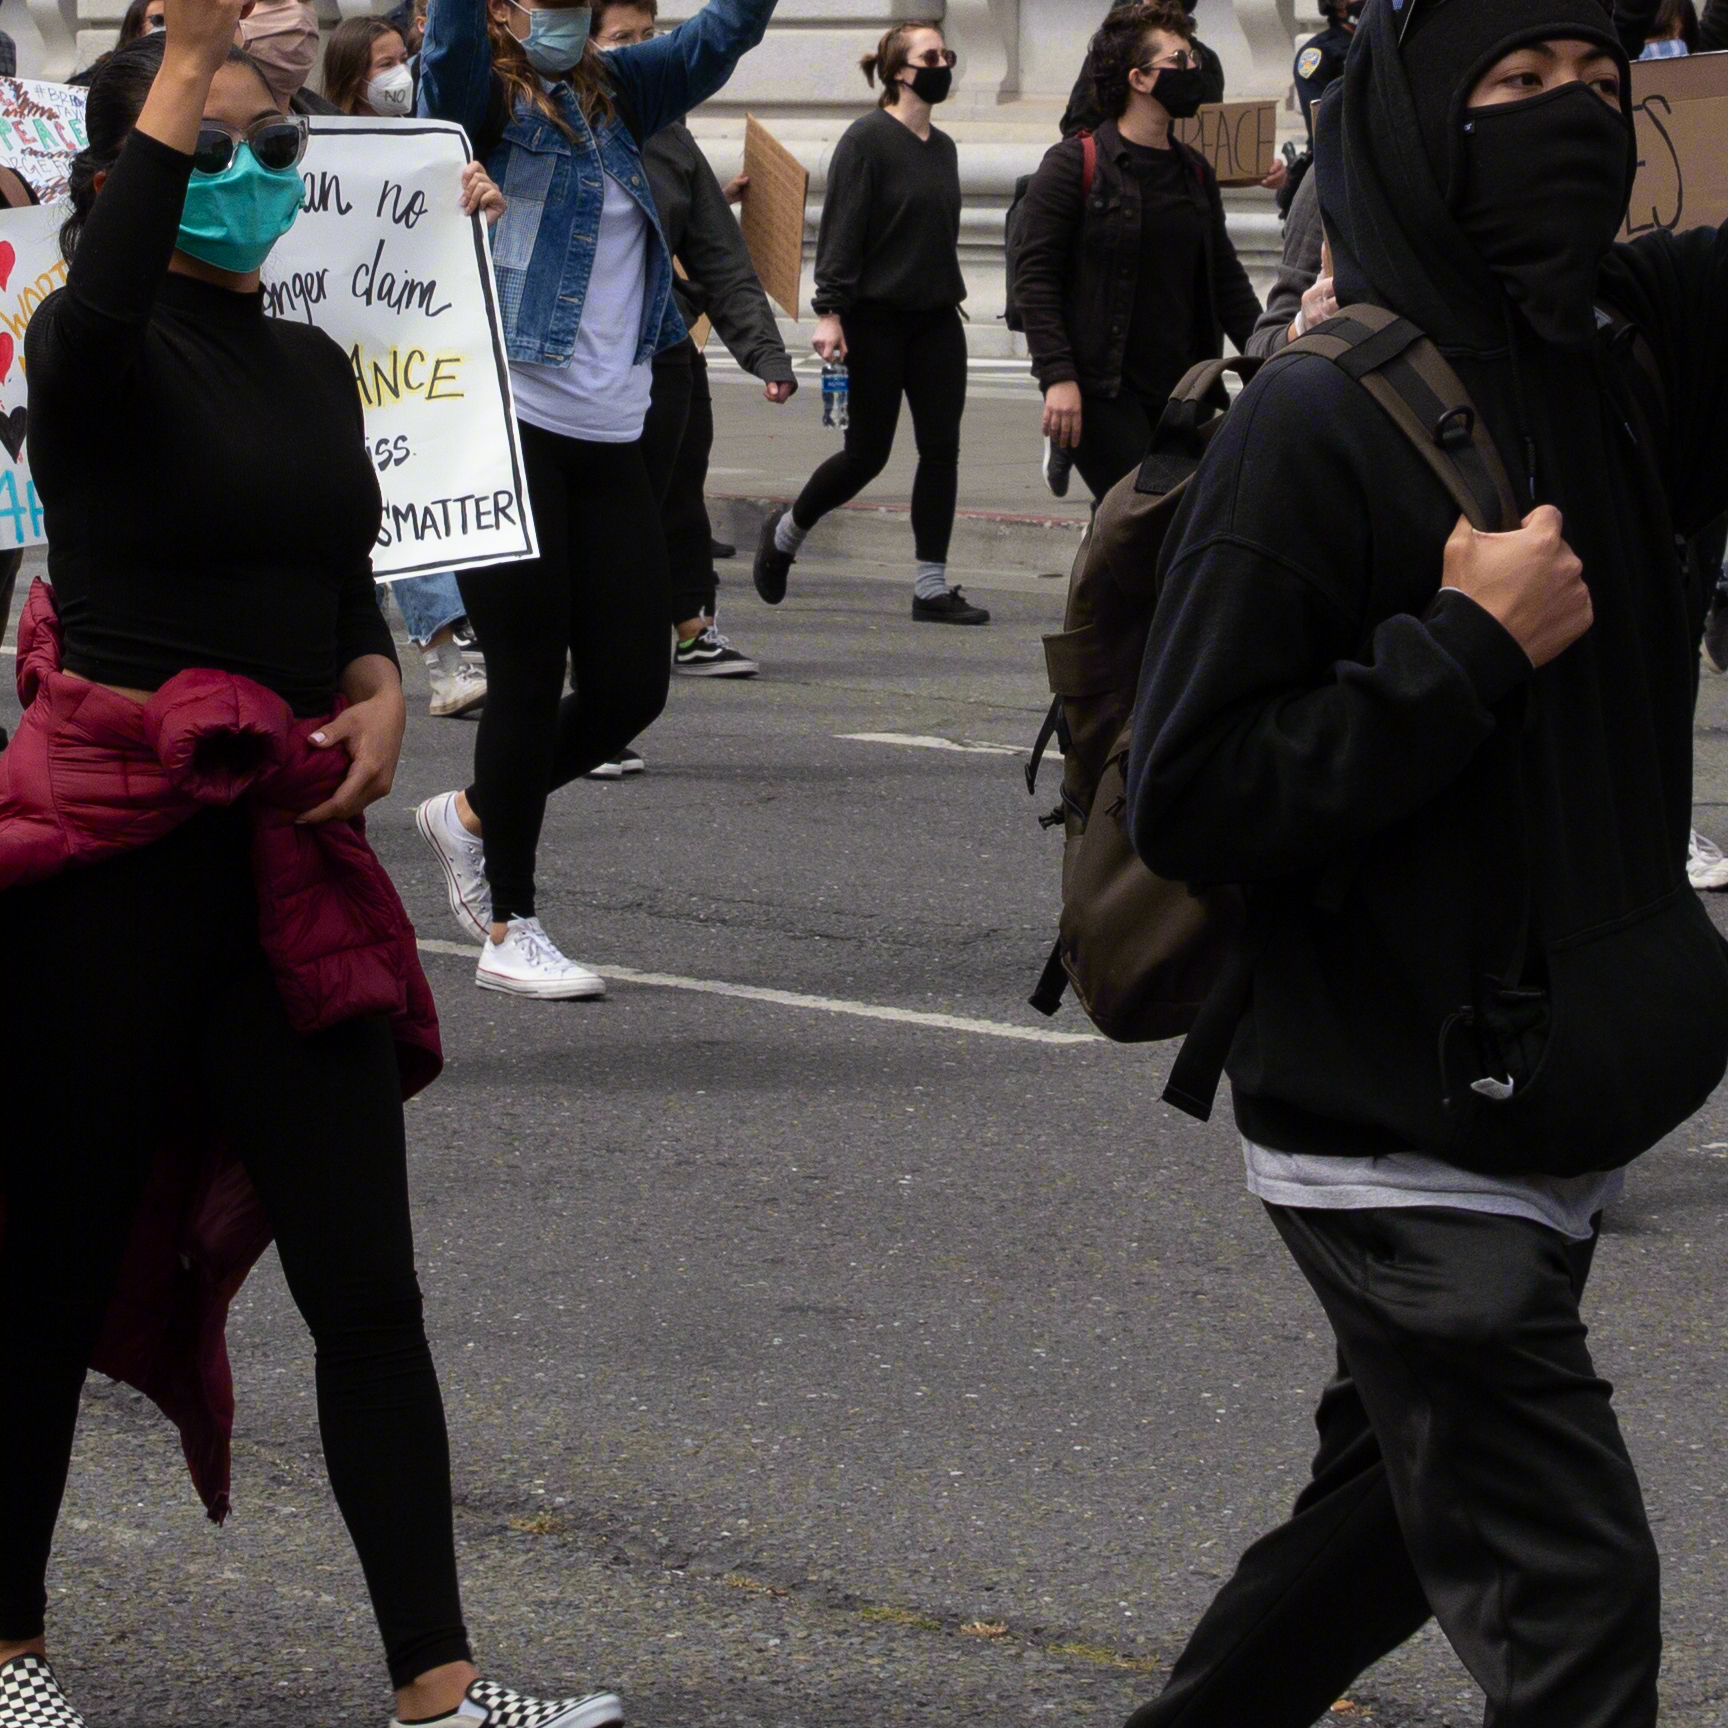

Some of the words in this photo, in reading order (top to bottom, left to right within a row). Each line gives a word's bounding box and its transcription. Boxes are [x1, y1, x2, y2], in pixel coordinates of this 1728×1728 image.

[384, 89, 406, 103] NO
[303, 171, 352, 216] an
[376, 179, 428, 229] no
[352, 239, 452, 317] claim
[352, 343, 464, 407] ANCE
[376, 490, 516, 547] SMATTER
